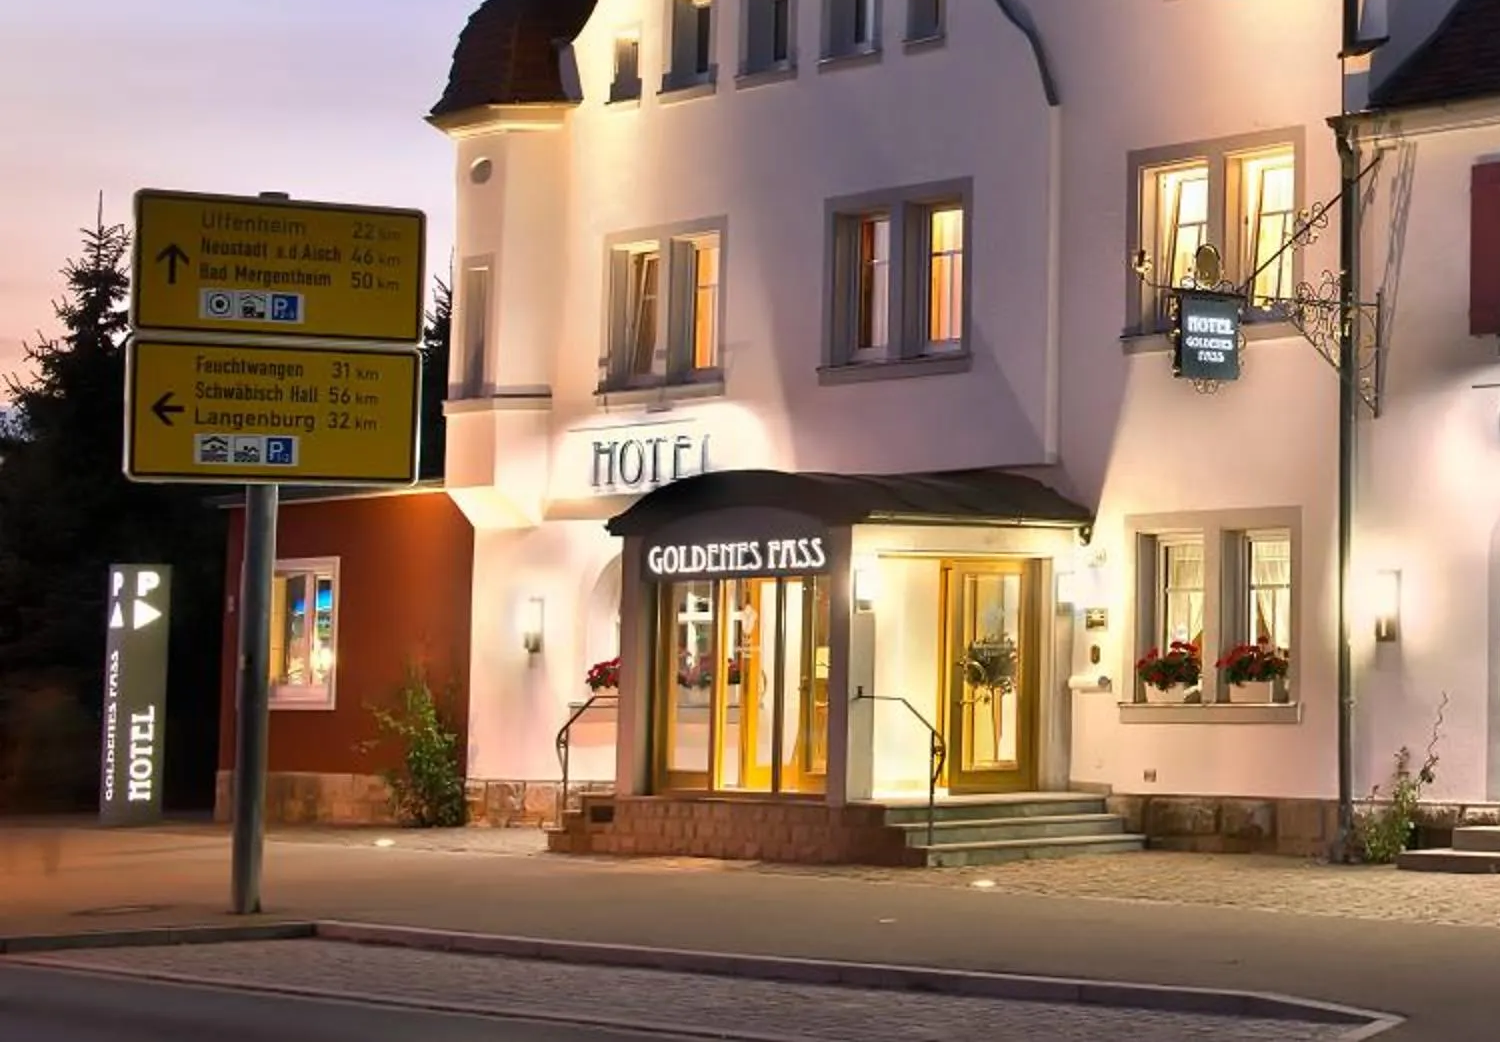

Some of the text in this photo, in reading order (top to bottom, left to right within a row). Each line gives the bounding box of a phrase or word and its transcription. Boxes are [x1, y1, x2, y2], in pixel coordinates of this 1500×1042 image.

[353, 222, 375, 240] 22
[378, 226, 401, 240] km
[201, 237, 268, 259] Neustadt
[351, 248, 374, 266] 46
[378, 254, 401, 267] km
[200, 263, 400, 291] Bad Mergentheim 50 km
[1187, 315, 1234, 335] HOTEL
[195, 355, 380, 381] Feuchtwangen 31 km
[290, 385, 318, 403] Hall
[328, 387, 351, 405] 56
[355, 393, 379, 406] km
[194, 407, 378, 433] Langenburg 32 km
[592, 434, 710, 486] HOTEL
[648, 537, 826, 574] GOLDENES FASS
[137, 571, 160, 597] P
[128, 706, 155, 801] HOTEL
